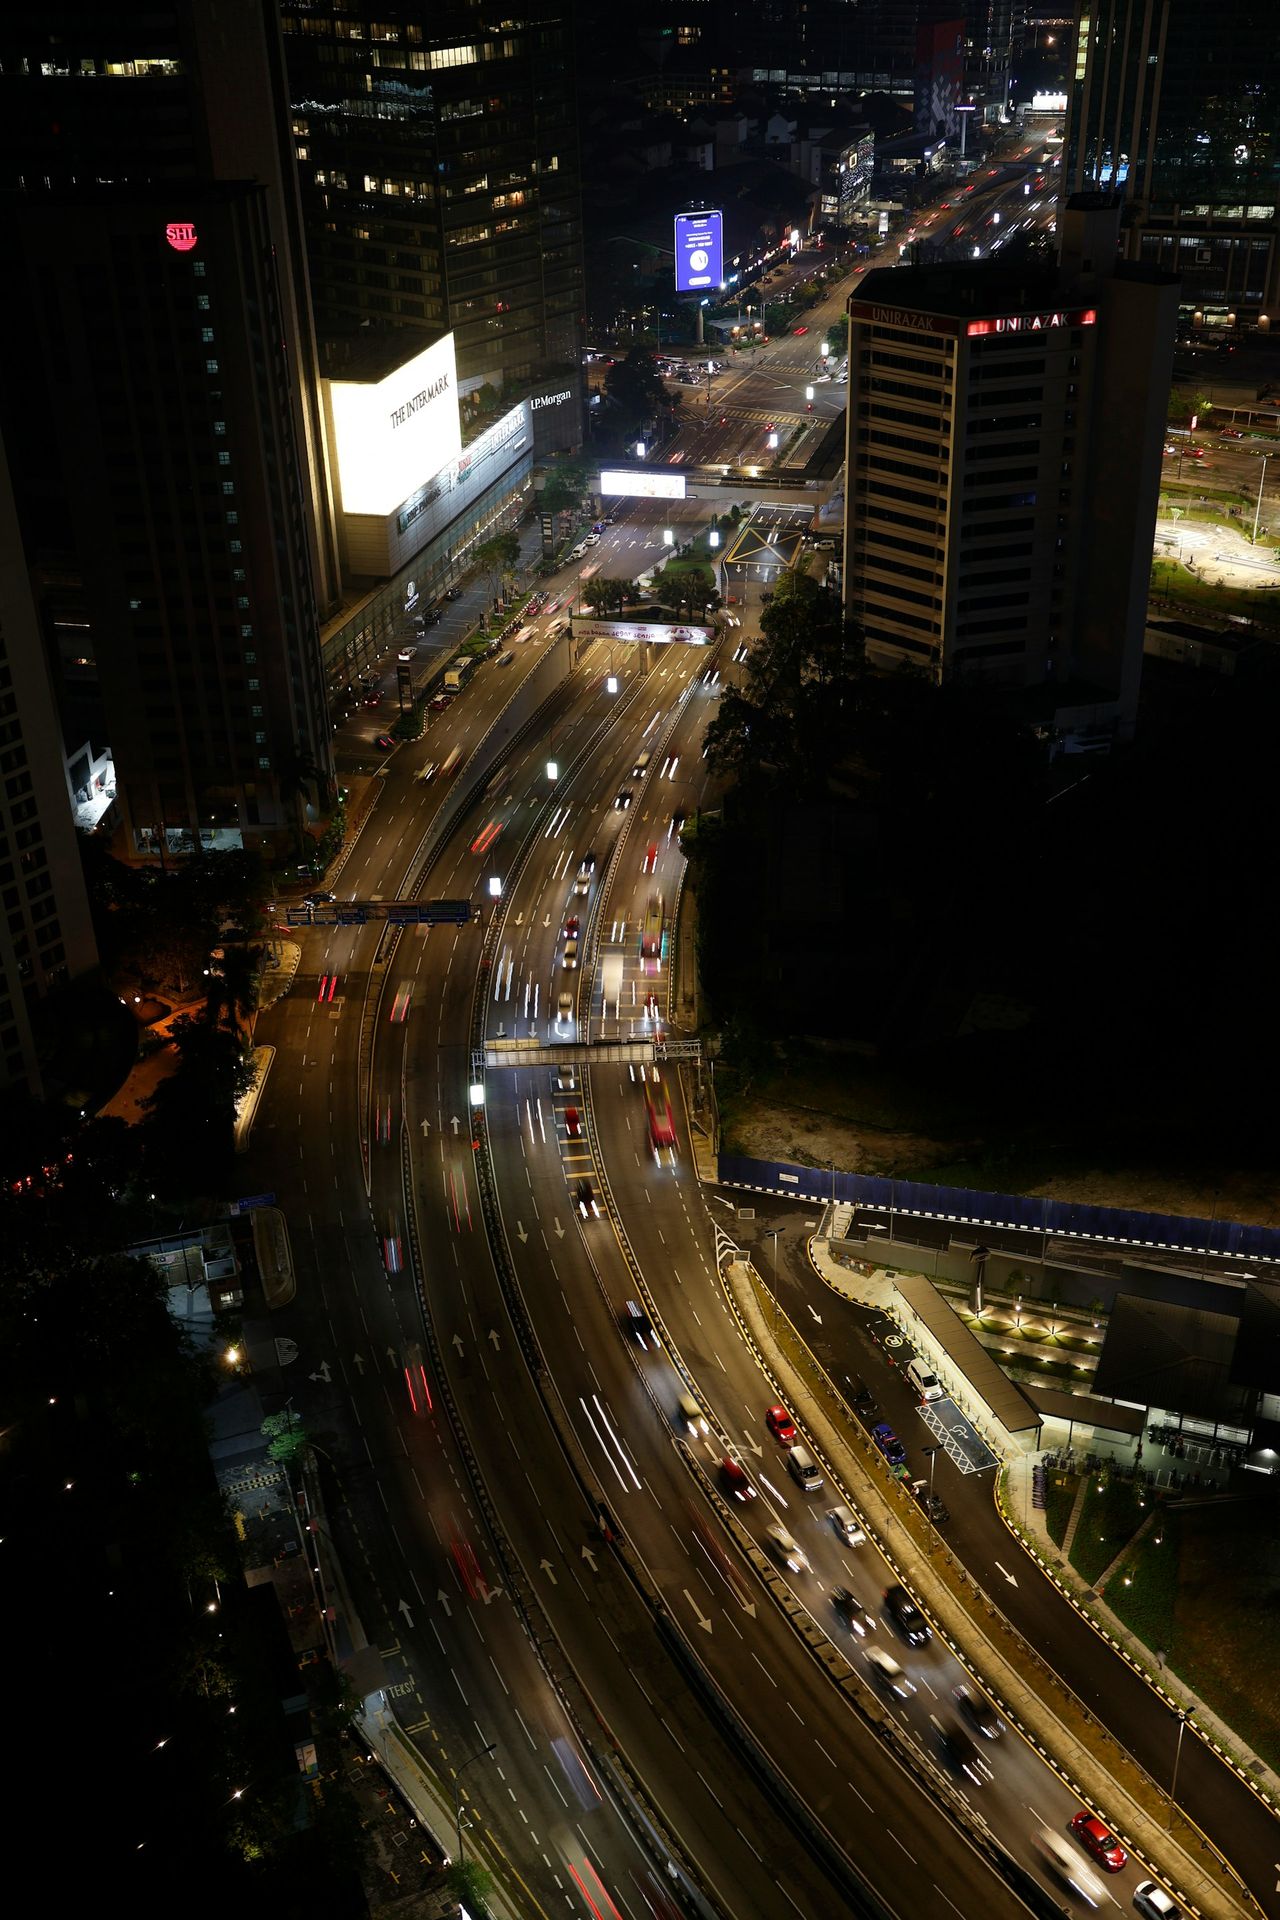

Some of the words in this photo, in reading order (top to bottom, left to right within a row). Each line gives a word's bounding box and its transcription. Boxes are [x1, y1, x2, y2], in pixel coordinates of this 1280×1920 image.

[166, 228, 198, 240] SHL
[872, 307, 934, 330] UNIRAZAK
[996, 313, 1069, 332] UNIRAZAK
[390, 405, 406, 429] THE
[406, 373, 449, 418] INTERMARK
[389, 1680, 415, 1699] TEKSI
